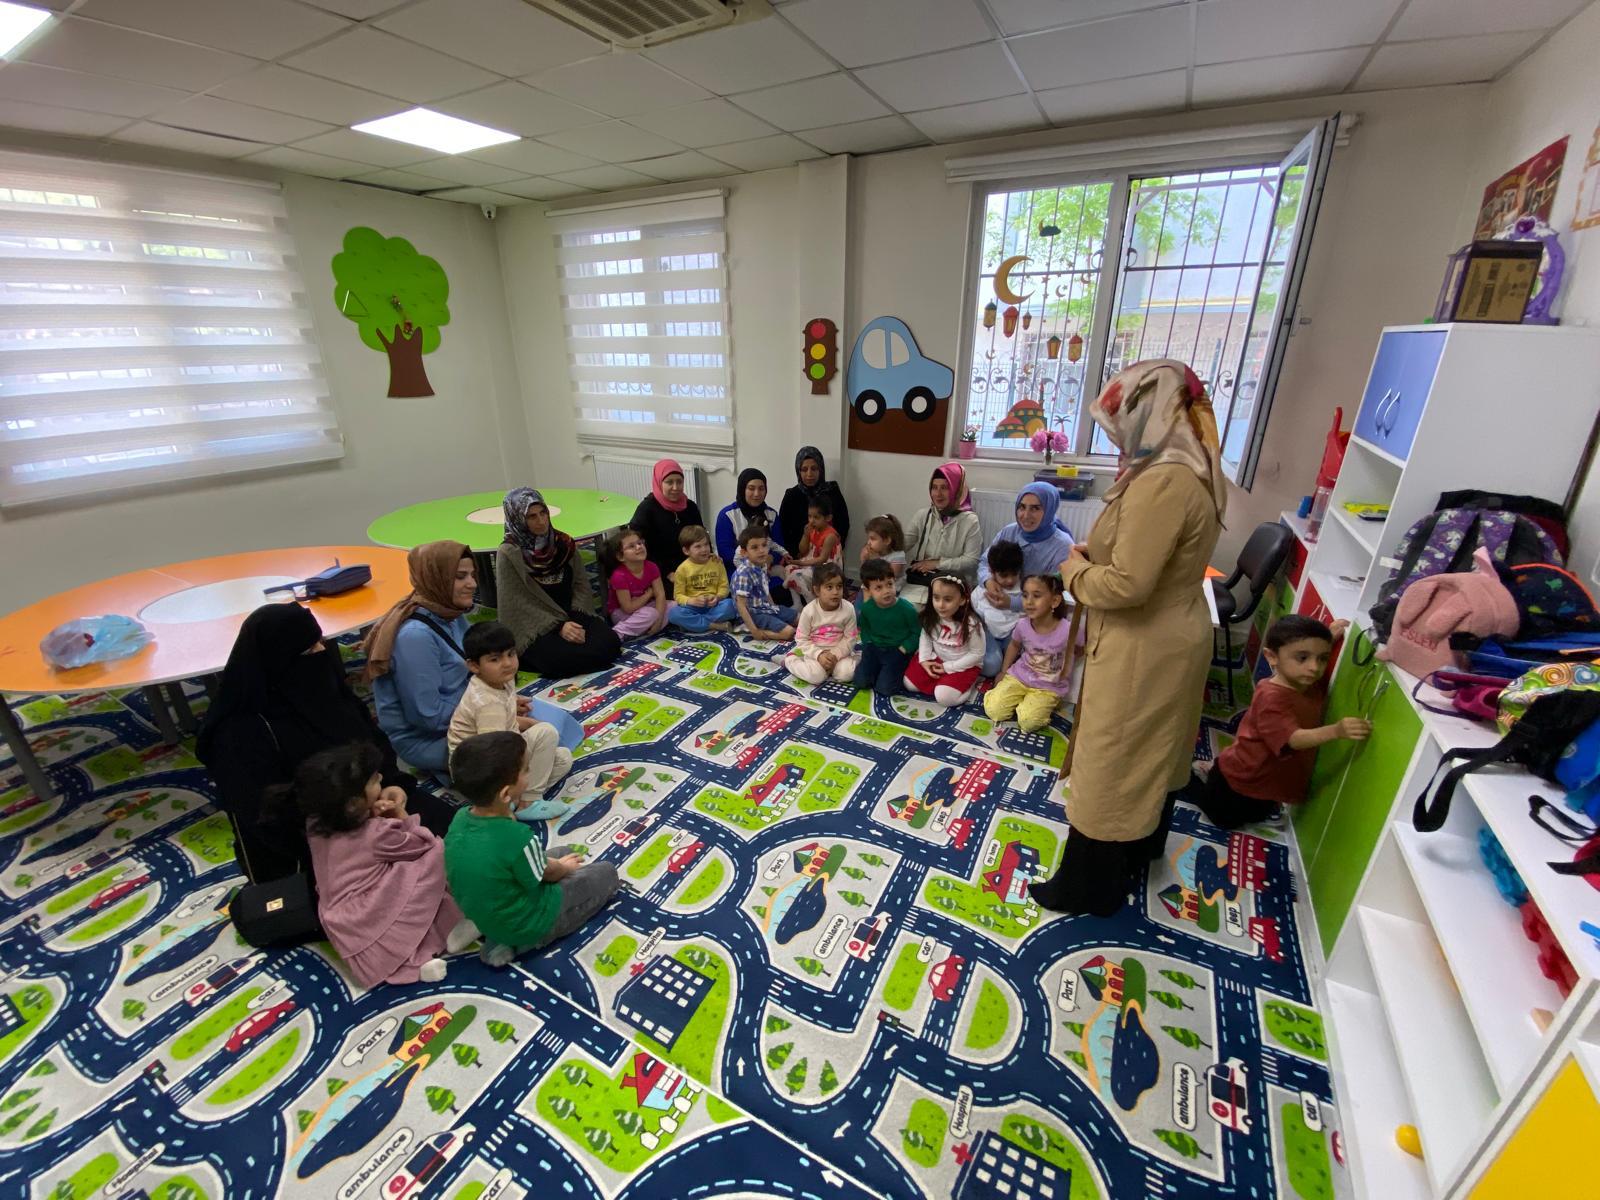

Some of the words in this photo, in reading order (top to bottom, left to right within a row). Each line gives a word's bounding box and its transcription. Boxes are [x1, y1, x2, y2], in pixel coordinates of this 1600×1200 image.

[590, 817, 621, 842] ambulance
[673, 833, 683, 842] car
[770, 858, 784, 873] Park
[639, 930, 662, 956] Hospital
[820, 918, 844, 955] ambulance
[922, 941, 931, 956] car
[155, 958, 213, 998] ambulance
[1061, 979, 1074, 1001] Park
[258, 985, 277, 1001] car
[357, 1029, 386, 1054] Park
[1177, 1067, 1189, 1125] ambulance
[952, 1090, 970, 1132] Hospital
[1305, 1099, 1318, 1121] car
[345, 1133, 407, 1198] ambulance
